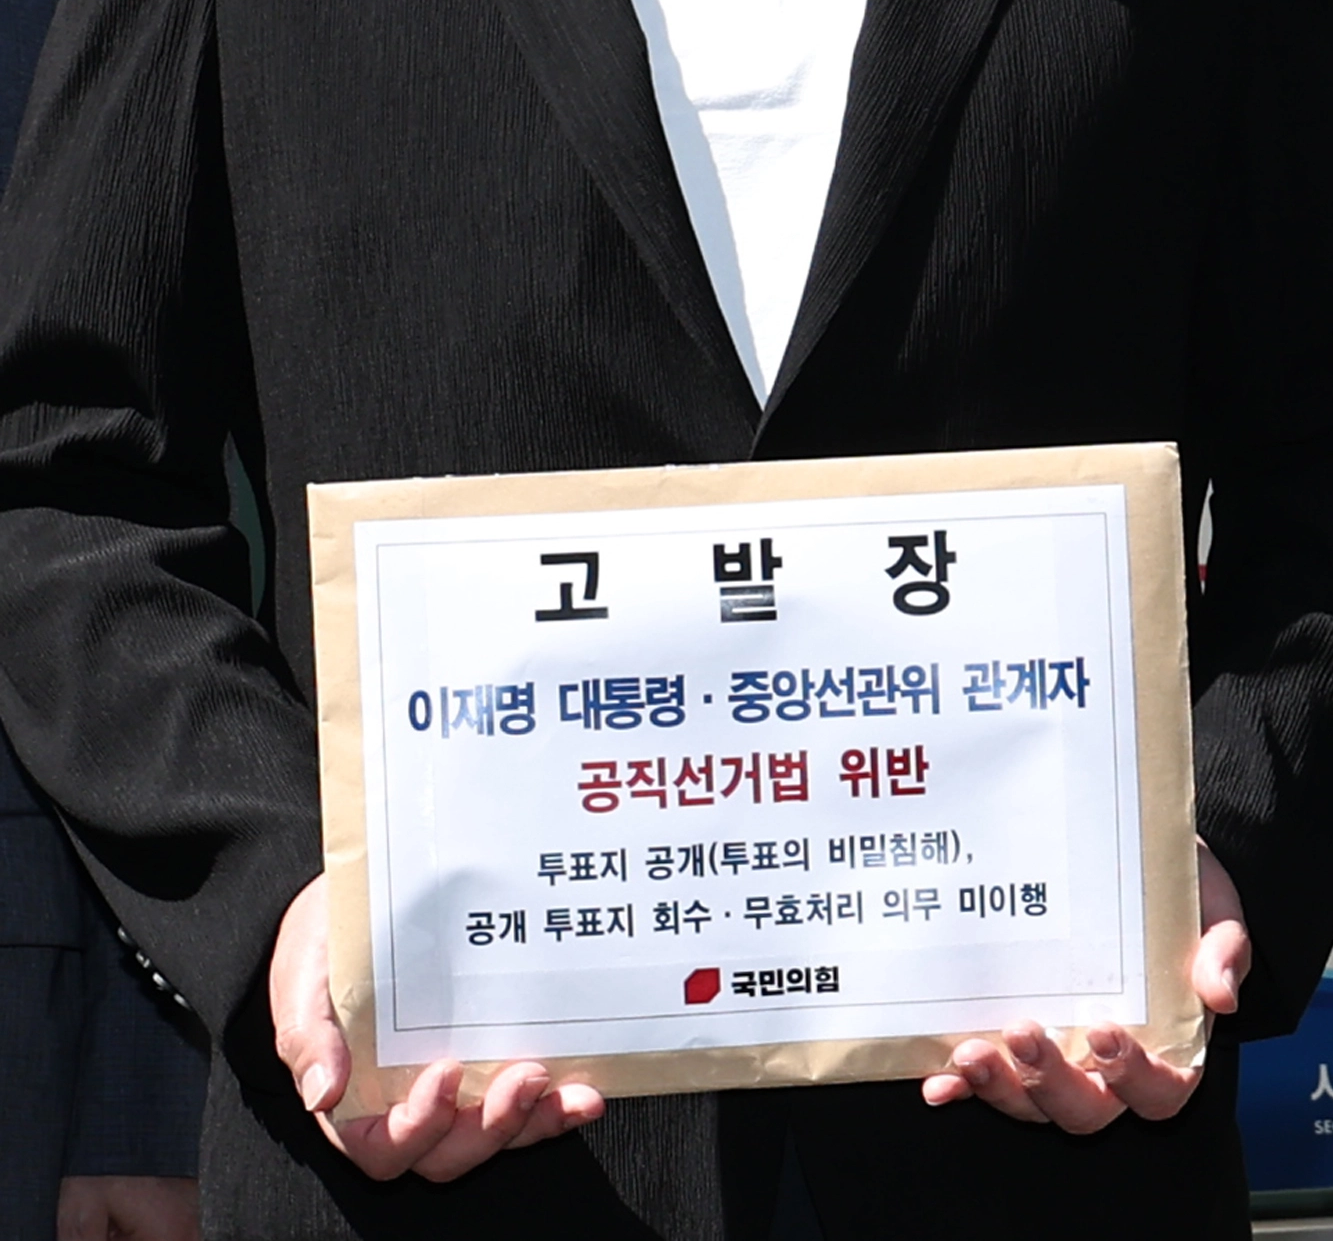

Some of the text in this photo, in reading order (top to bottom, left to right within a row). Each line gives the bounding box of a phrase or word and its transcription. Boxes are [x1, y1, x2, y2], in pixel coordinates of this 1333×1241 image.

[408, 681, 536, 738] 이재명
[963, 657, 1090, 711] 관계자
[578, 745, 929, 813] 공직선거법 위반
[538, 849, 626, 886] 투표지
[466, 910, 526, 945] 공개
[544, 904, 633, 942] 투표지
[882, 887, 942, 922] 의무
[960, 883, 1046, 918] 미이행
[731, 966, 839, 997] 국민의힘
